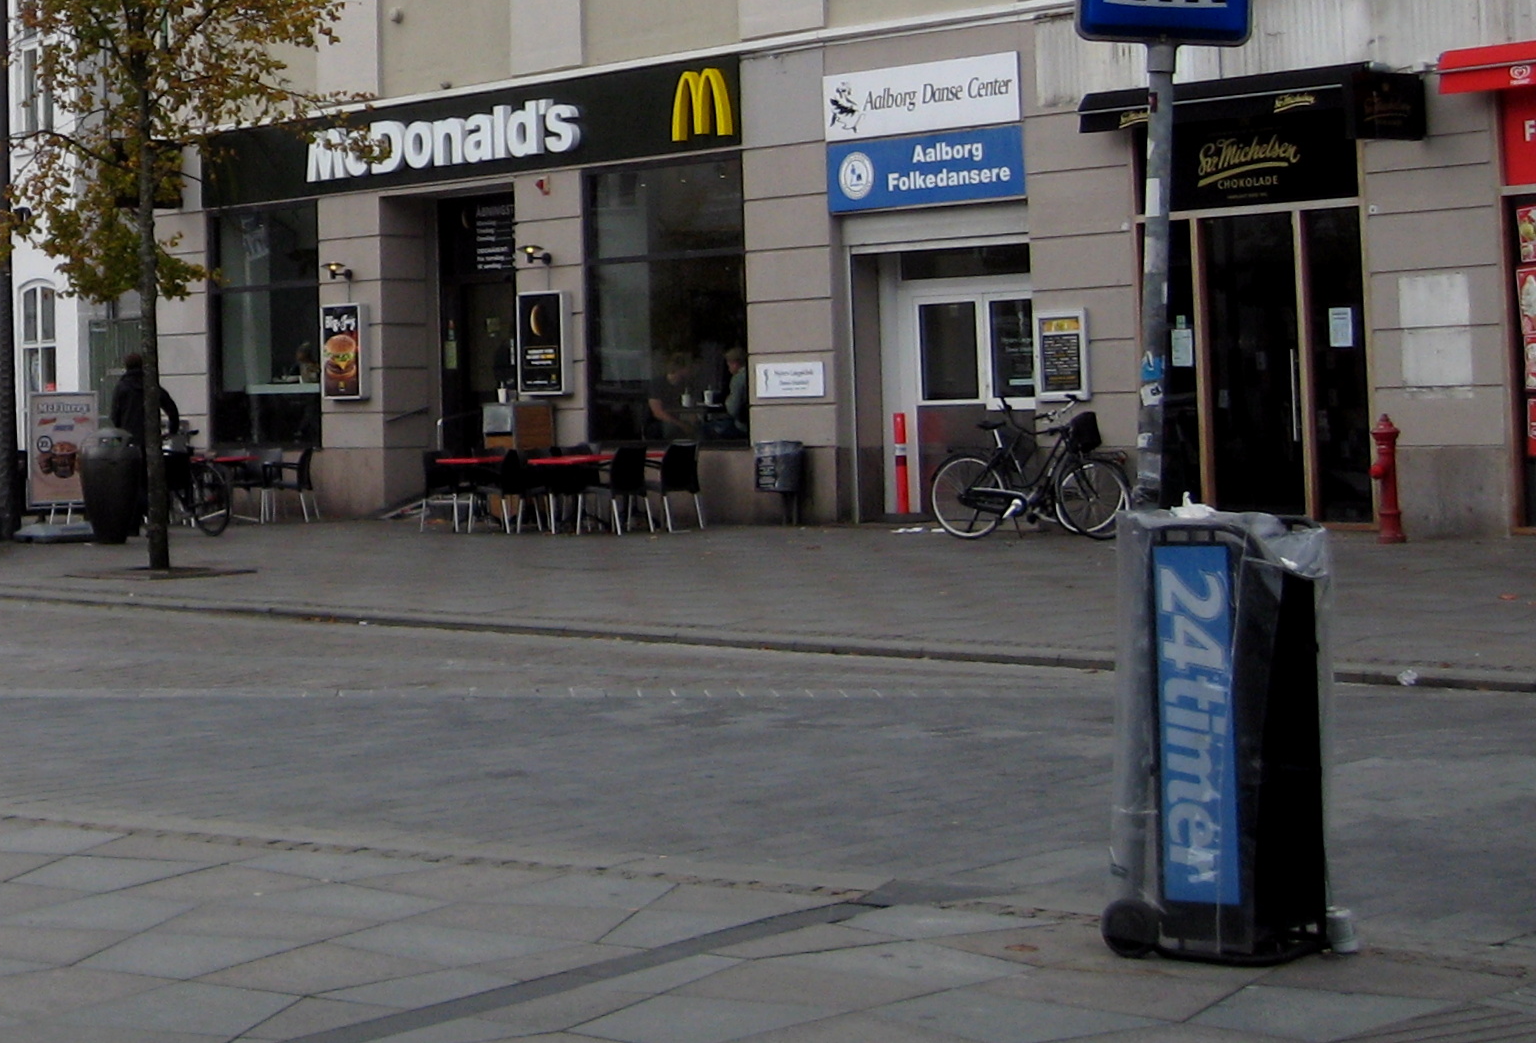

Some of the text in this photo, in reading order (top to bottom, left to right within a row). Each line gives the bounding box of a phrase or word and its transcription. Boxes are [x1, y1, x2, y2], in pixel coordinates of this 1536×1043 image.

[863, 77, 1013, 112] Aalborg Danse Center
[306, 98, 581, 183] McDonald's
[912, 142, 983, 164] Aalborg
[1216, 134, 1302, 170] Michelsen
[887, 166, 1012, 192] Folkedansere
[1217, 175, 1279, 190] CHOKOLADE
[1160, 567, 1229, 883] 24timer
